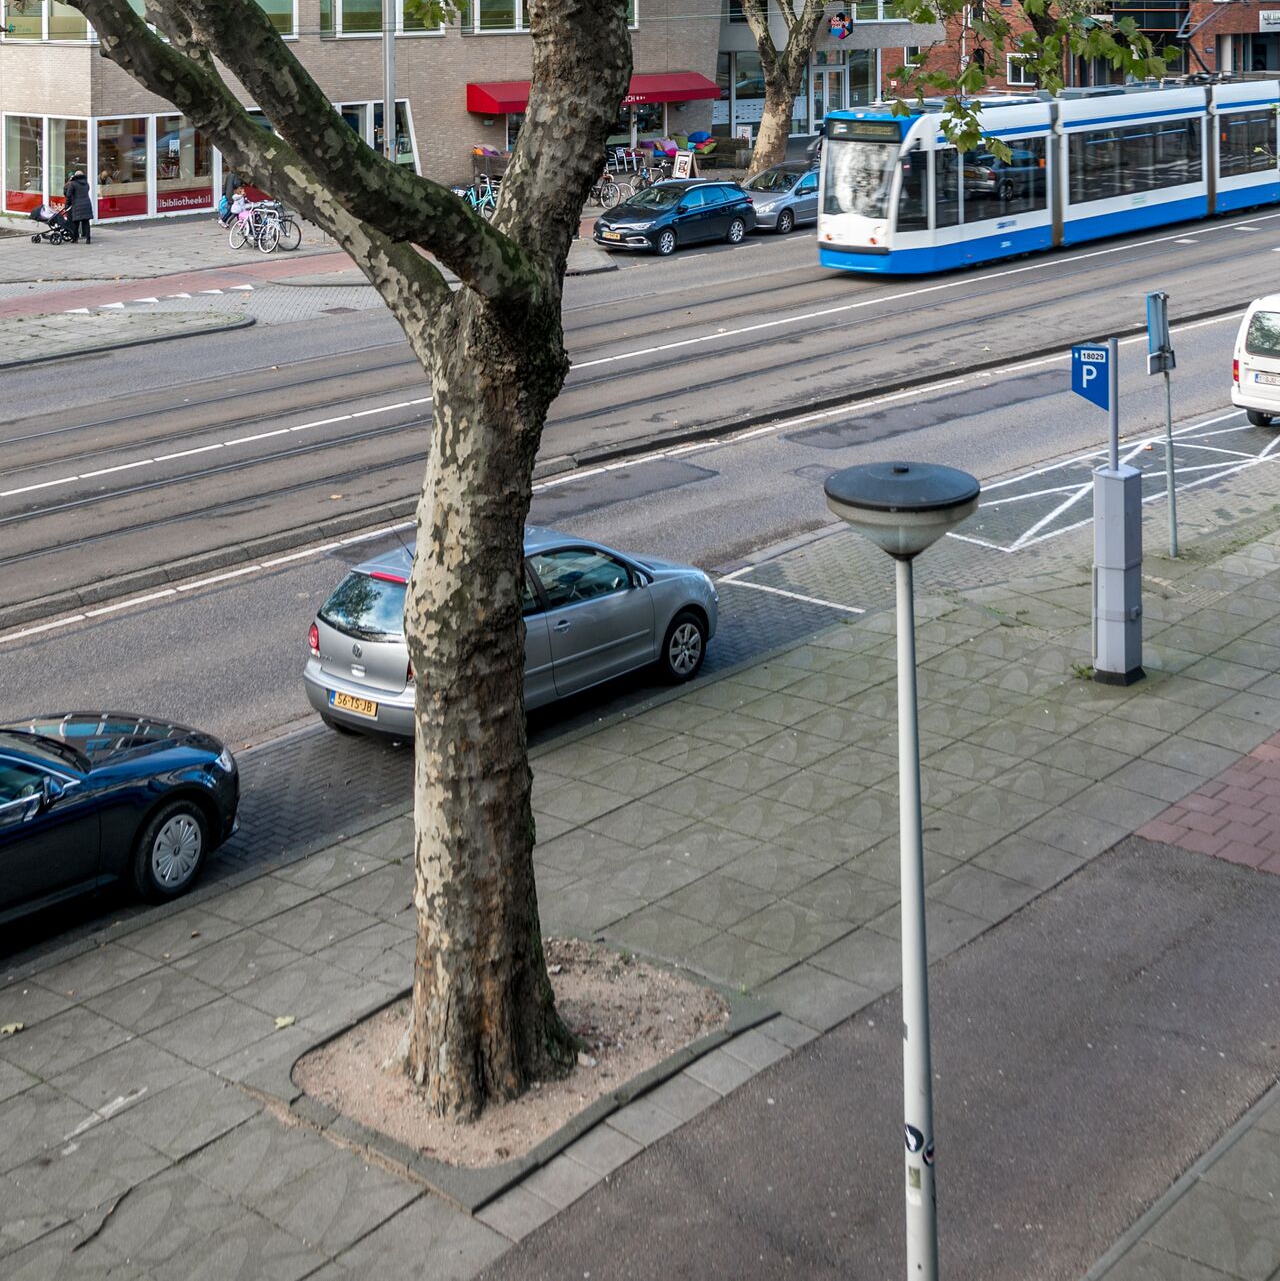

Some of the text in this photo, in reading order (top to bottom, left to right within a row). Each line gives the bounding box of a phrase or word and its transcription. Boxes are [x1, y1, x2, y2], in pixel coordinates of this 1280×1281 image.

[161, 195, 203, 208] bibliotheek
[1082, 352, 1105, 360] 18029
[1082, 364, 1097, 388] P
[337, 693, 373, 713] 56-TS-JB
